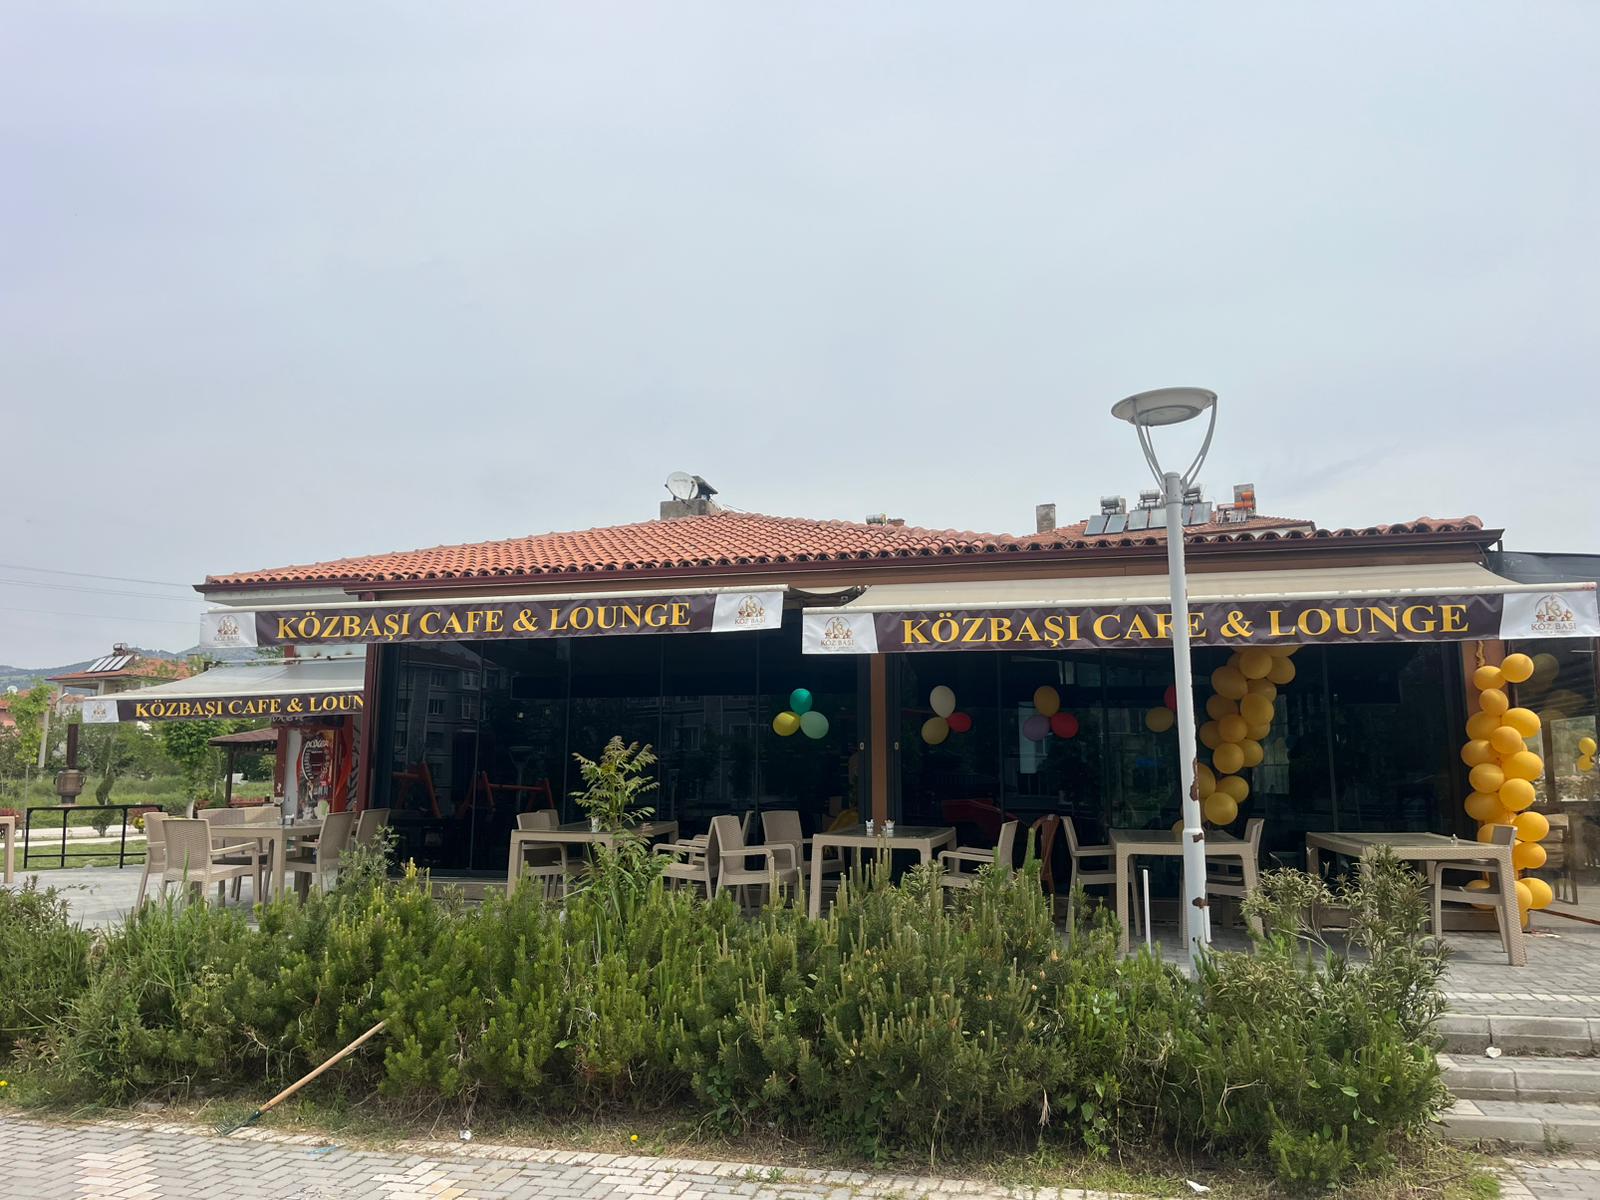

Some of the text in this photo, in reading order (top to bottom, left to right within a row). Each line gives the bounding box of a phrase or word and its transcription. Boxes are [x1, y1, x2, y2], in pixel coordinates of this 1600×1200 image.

[276, 602, 691, 642] KÖZBAŞI CAFE & LOUNGE
[903, 603, 1469, 647] KÖZBAŞI CAFE & LOUNGE
[135, 699, 223, 719] KÖZBAŞI
[228, 698, 282, 715] CAFE
[286, 697, 304, 713] &
